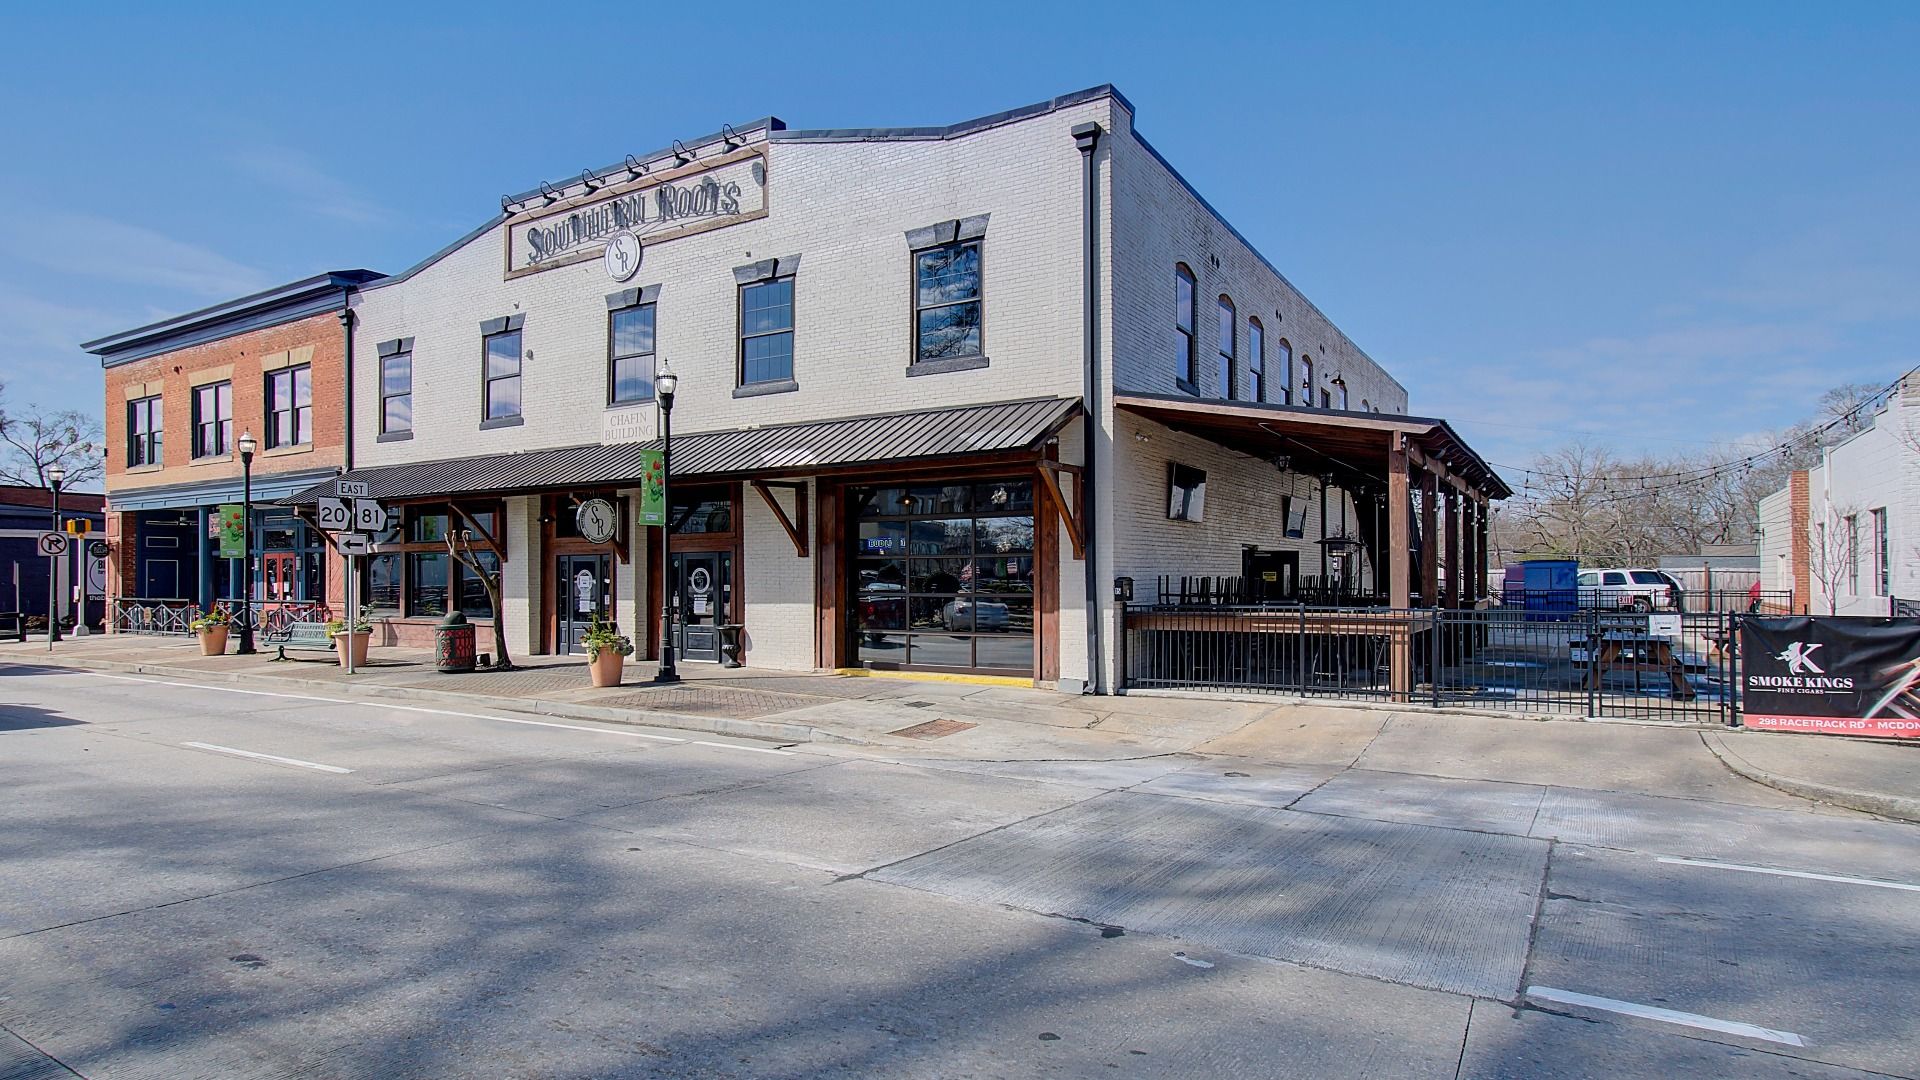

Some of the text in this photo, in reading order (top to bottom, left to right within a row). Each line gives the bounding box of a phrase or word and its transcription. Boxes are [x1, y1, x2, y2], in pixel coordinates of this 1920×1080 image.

[527, 192, 646, 264] SOUTHERN
[658, 181, 741, 220] ROOTS
[610, 412, 647, 426] CHAFIN
[605, 425, 653, 441] BUILDING
[341, 483, 364, 495] EAST
[321, 506, 345, 522] 20
[362, 508, 379, 524] 81
[1618, 596, 1632, 604] EXIT
[1749, 675, 1853, 689] SMOKE KINGS
[1758, 718, 1777, 726] 298
[1780, 718, 1847, 728] RACETRACK
[1850, 721, 1865, 729] RD
